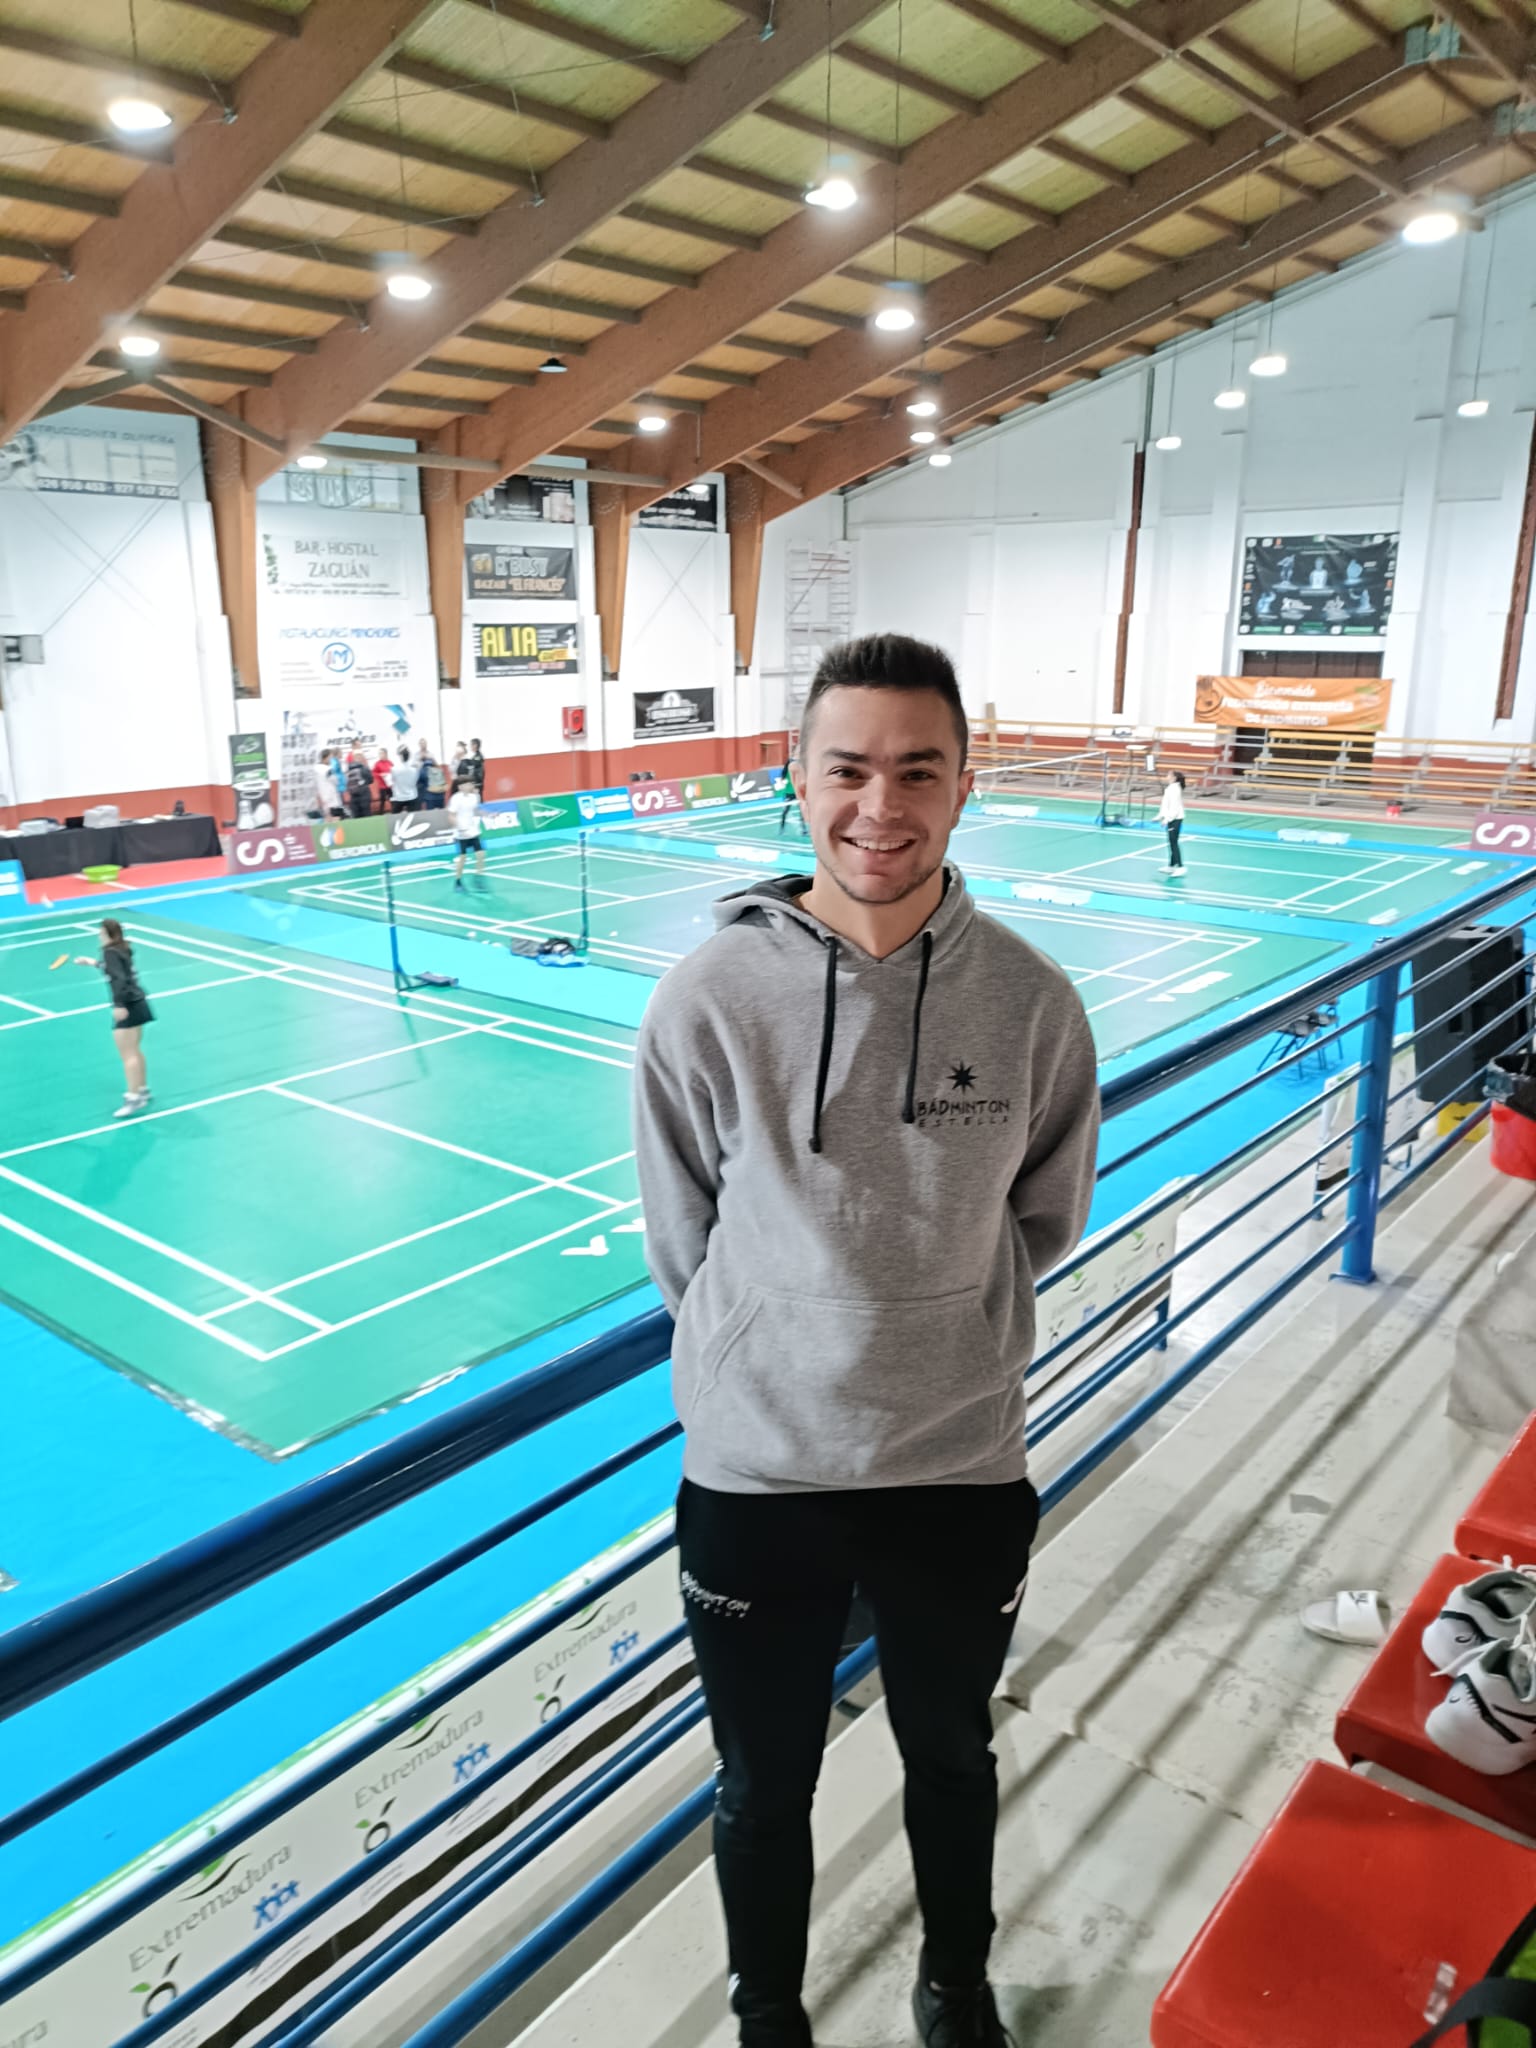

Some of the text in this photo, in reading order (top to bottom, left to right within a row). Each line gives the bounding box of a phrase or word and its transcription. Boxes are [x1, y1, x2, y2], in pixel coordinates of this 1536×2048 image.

[295, 540, 379, 557] BAR-HOSTAL
[481, 626, 538, 657] ALIA
[534, 1600, 638, 1683] Extremadura
[355, 1709, 484, 1810] Extremadura
[128, 1845, 292, 1973] Extremadura
